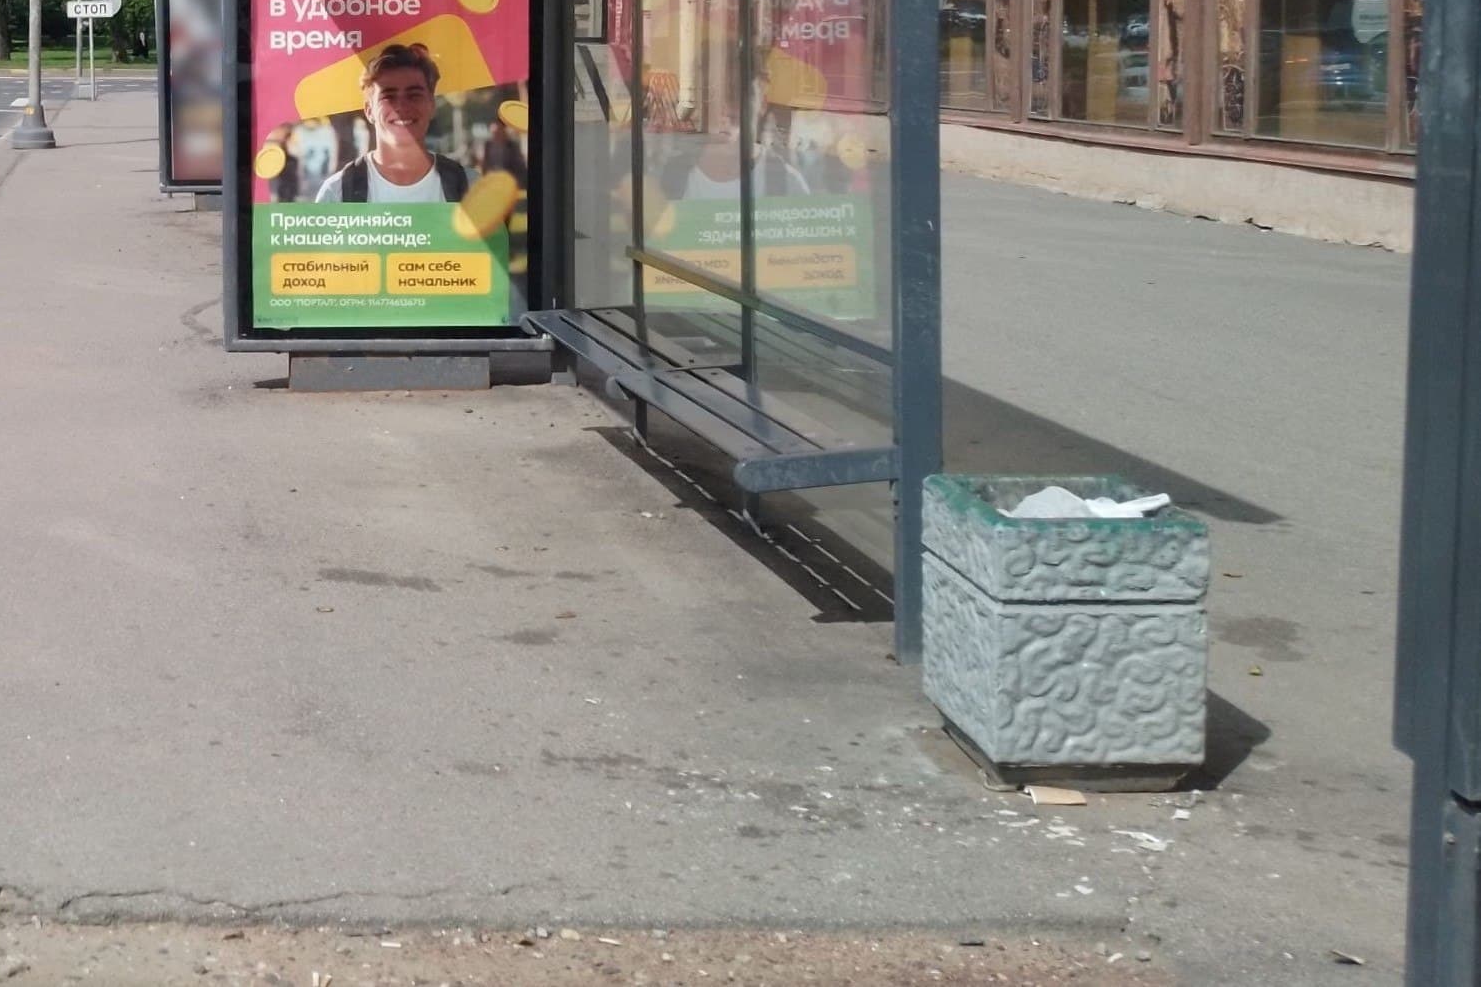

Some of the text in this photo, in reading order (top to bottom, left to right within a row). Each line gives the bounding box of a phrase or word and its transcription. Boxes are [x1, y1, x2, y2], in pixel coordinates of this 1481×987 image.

[74, 4, 107, 14] СТОП
[270, 30, 363, 55] время
[270, 213, 413, 229] Присоединяйся
[271, 230, 432, 248] к нашей команде:
[283, 260, 370, 272] стабильный
[398, 260, 462, 272] сам себе
[283, 277, 326, 288] доход
[398, 277, 477, 287] начальник
[270, 299, 292, 307] ООО
